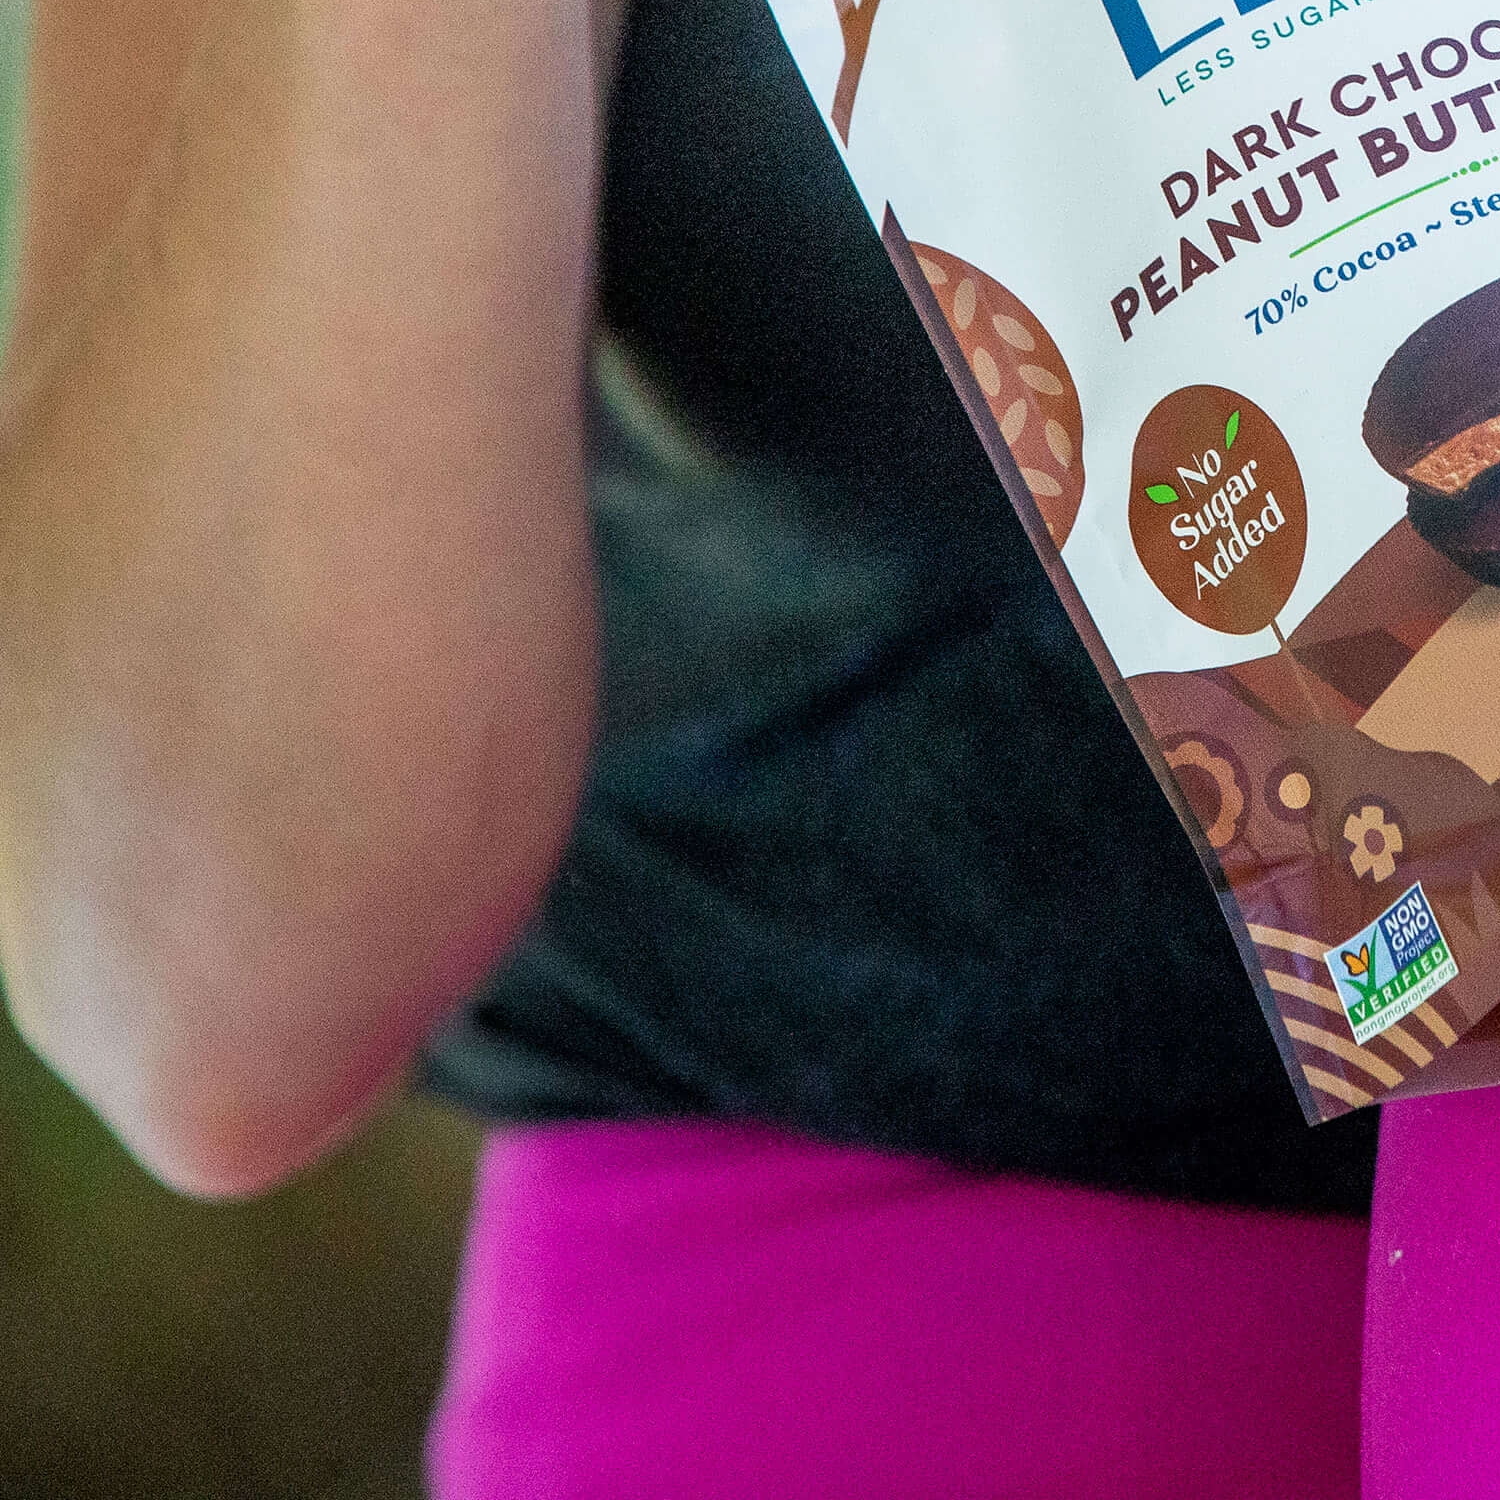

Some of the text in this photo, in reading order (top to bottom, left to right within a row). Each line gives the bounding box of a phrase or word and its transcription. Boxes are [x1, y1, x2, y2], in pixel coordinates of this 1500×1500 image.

[1157, 48, 1236, 107] LESS
[1159, 97, 1321, 220] DARK
[1109, 148, 1343, 343] PEANUT
[1245, 284, 1309, 336] 70%
[1312, 230, 1418, 298] Cocoa
[1169, 459, 1258, 550] Sugar
[1176, 449, 1222, 499] No
[1193, 491, 1286, 600] Added
[1384, 893, 1422, 936] NON
[1391, 911, 1429, 951] GMO
[1396, 928, 1437, 967] Project
[1354, 949, 1443, 1021] VERIFIED
[1356, 962, 1457, 1040] nongmoproject.org
